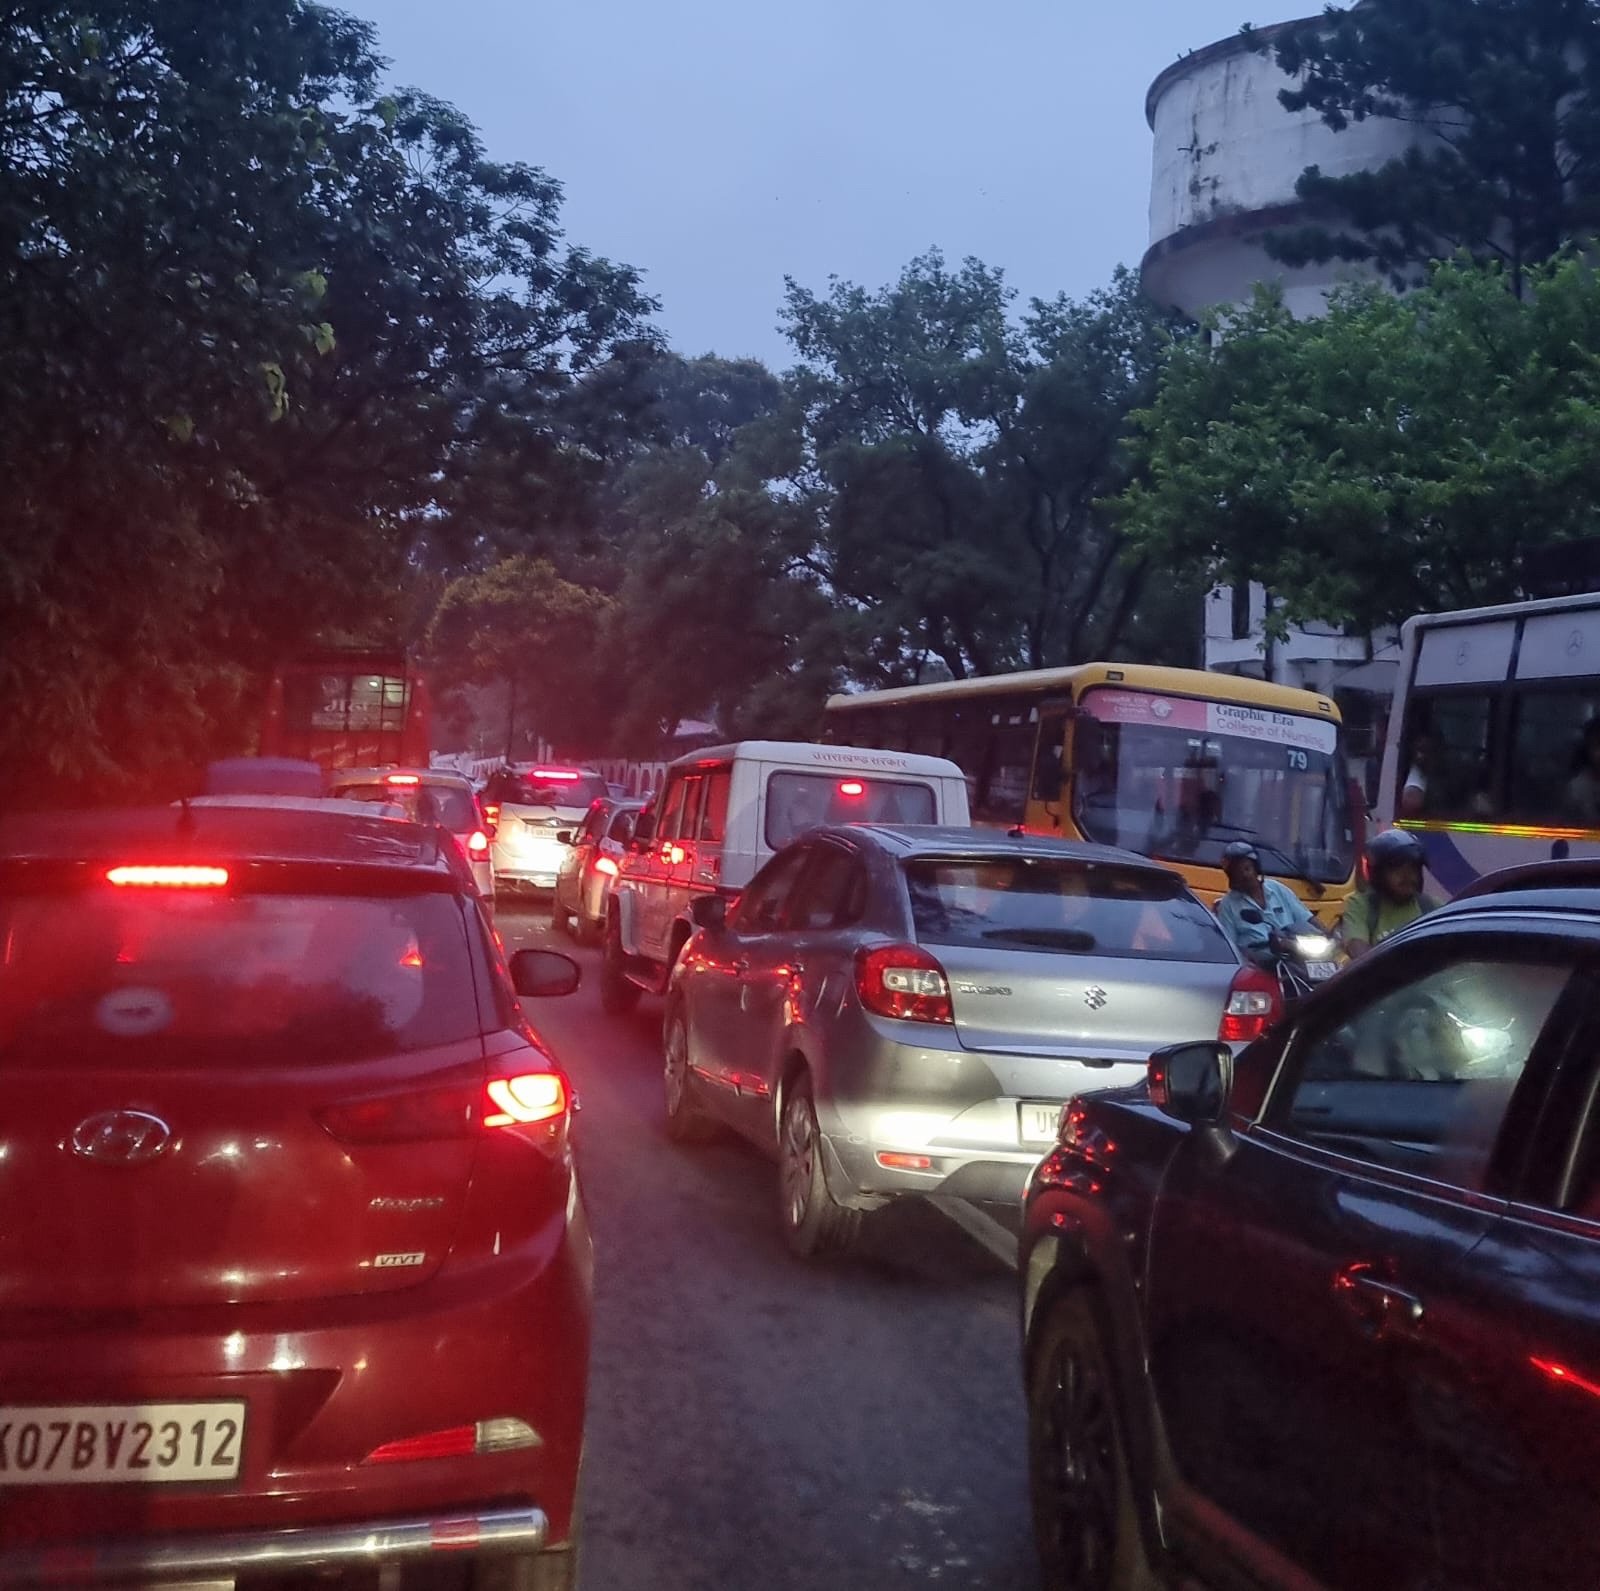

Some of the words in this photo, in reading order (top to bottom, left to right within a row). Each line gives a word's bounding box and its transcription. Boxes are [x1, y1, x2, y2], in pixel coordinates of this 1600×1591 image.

[1216, 703, 1268, 722] Graphic
[1272, 712, 1294, 726] Era
[1216, 717, 1264, 736] College
[1267, 726, 1280, 735] of
[1282, 728, 1325, 749] Nursing
[1288, 750, 1308, 770] 79
[380, 1255, 420, 1265] VTVT
